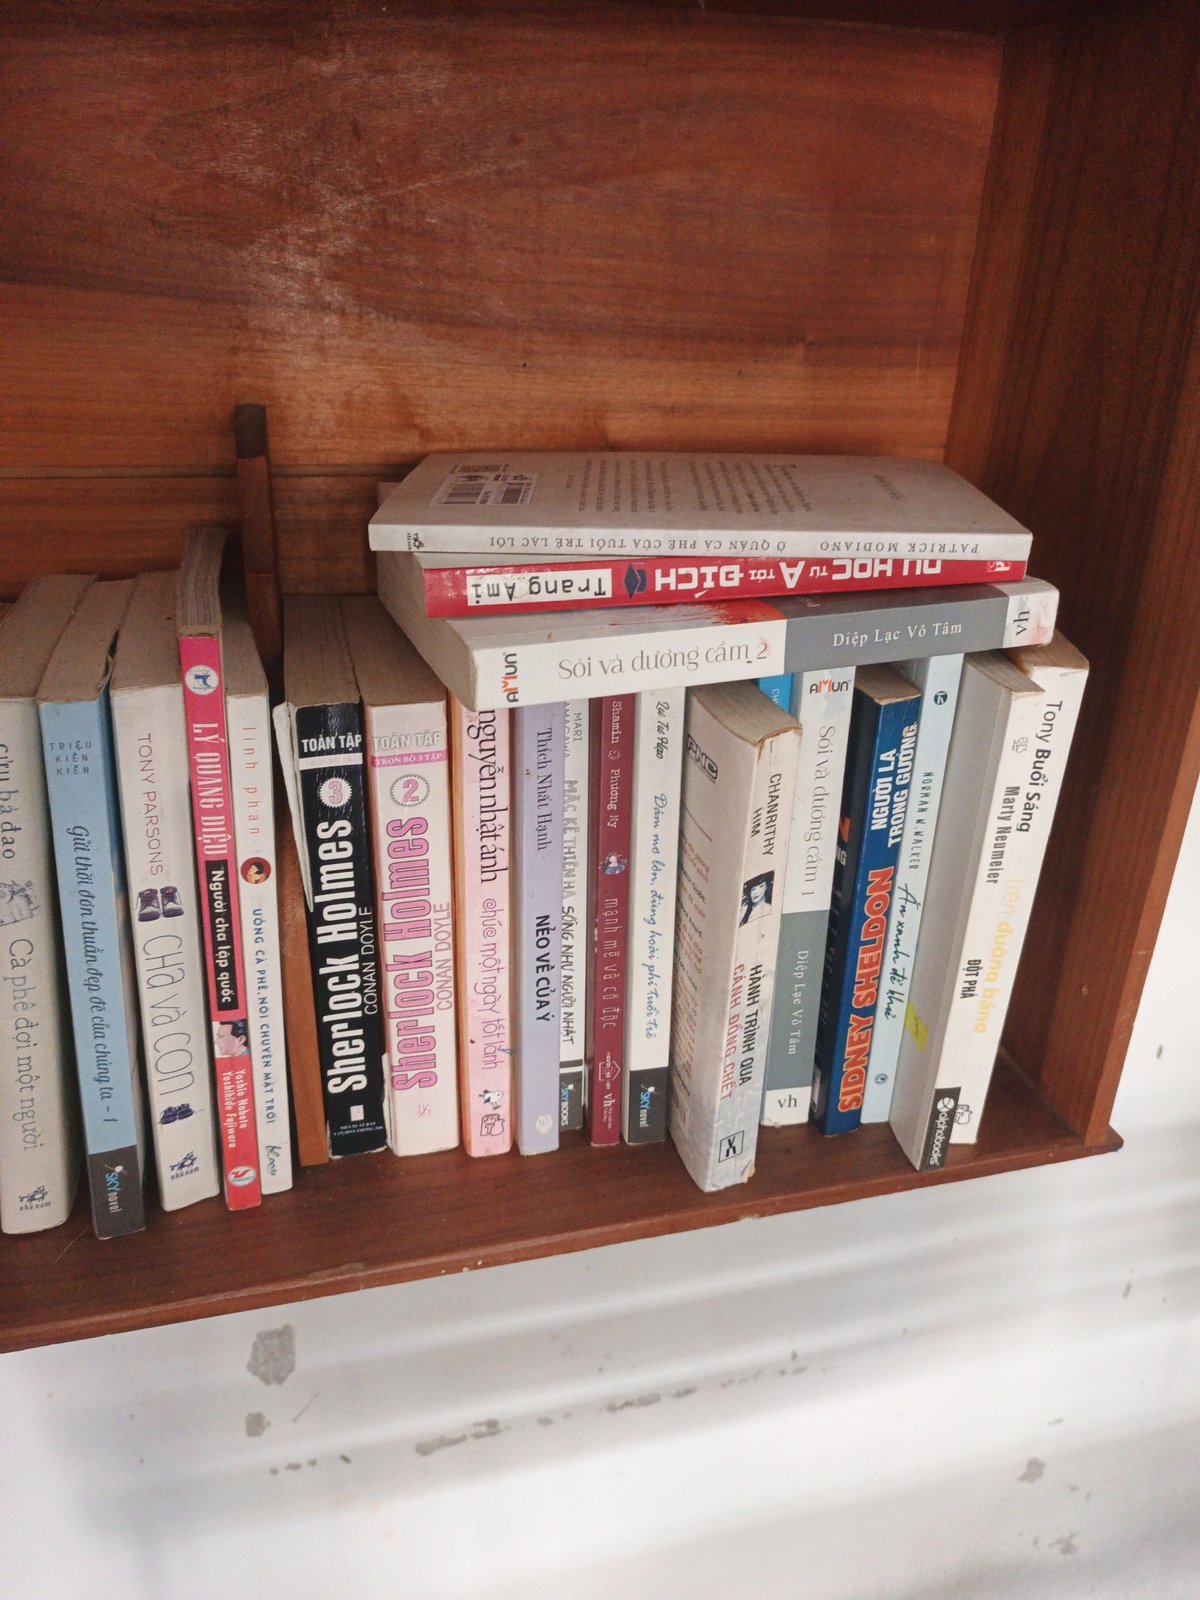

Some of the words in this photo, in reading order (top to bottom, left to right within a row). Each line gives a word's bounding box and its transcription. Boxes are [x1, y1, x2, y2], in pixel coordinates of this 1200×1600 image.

[520, 535, 548, 548] LẠC
[669, 538, 699, 554] PHÊ
[705, 539, 724, 554] CÀ
[729, 539, 771, 555] QUÁN
[820, 540, 900, 553] MODIANO
[908, 541, 980, 554] PATRICK
[528, 576, 606, 597] Trang
[655, 564, 745, 599] ĐÍCH
[780, 561, 806, 589] A
[471, 582, 516, 604] Ami
[832, 630, 869, 647] Diệp
[874, 627, 901, 643] Lạc
[907, 622, 926, 638] Vô
[931, 620, 962, 636] Tâm
[1013, 610, 1031, 636] vh
[558, 657, 592, 680] Sói
[598, 654, 624, 675] và
[631, 646, 699, 673] dương
[704, 640, 749, 664] cầm
[756, 643, 768, 660] 2
[192, 722, 225, 744] LÝ
[573, 712, 582, 741] MARI
[611, 700, 622, 744] Shamin
[1036, 700, 1063, 743] Tony
[242, 727, 260, 769] linh
[301, 734, 336, 753] TOÀN
[338, 732, 362, 751] TẬP
[466, 709, 505, 791] nguyễn
[536, 728, 553, 769] Thích
[653, 736, 669, 760] Hạo
[816, 725, 836, 754] Sói
[895, 720, 919, 785] GƯƠNG
[137, 733, 156, 783] TONY
[813, 759, 832, 780] và
[877, 748, 897, 772] LẠ
[1029, 749, 1052, 787] Buổi
[192, 752, 222, 809] QUANG
[328, 780, 343, 805] 3
[402, 779, 420, 801] 2
[536, 773, 554, 809] Nhất
[607, 768, 621, 811] Phương
[919, 771, 935, 813] NORMAN
[243, 787, 262, 834] phan
[475, 795, 509, 843] nhật
[762, 773, 782, 856] CHANRITHY
[804, 785, 831, 842] dương
[871, 776, 893, 830] NGƯỜI
[887, 785, 910, 848] TRONG
[996, 786, 1020, 821] Marty
[1017, 792, 1041, 833] Sáng
[66, 826, 90, 852] Gửi
[142, 791, 163, 876] PARSONS
[197, 815, 232, 856] DIỆU
[534, 813, 553, 851] Hạnh
[750, 808, 763, 838] HIM
[1, 821, 23, 860] đao
[651, 833, 661, 855] mơ
[986, 826, 1012, 884] Neumeier
[72, 857, 94, 885] thời
[381, 816, 434, 942] Holmes
[479, 844, 508, 885] ánh
[803, 846, 822, 883] cầm
[208, 870, 228, 913] Người
[314, 819, 360, 945] Holmes
[1003, 879, 1023, 914] trên
[77, 889, 96, 917] đơn
[602, 898, 622, 933] mạnh
[643, 889, 664, 925] đừng
[898, 883, 921, 917] Ăn
[215, 917, 230, 941] cha
[252, 908, 266, 944] UỐNG
[358, 906, 376, 955] DOYLE
[433, 902, 451, 953] DOYLE
[481, 898, 505, 939] chúc
[535, 915, 556, 948] NẺO
[561, 906, 579, 940] SỐNG
[9, 938, 35, 969] Cà
[81, 921, 105, 963] thuần
[602, 940, 620, 957] mẽ
[648, 930, 663, 960] hoài
[851, 866, 895, 1009] SHELDON
[893, 920, 910, 964] xanh
[984, 920, 1014, 982] đường
[213, 944, 235, 968] lập
[254, 950, 268, 965] CÀ
[478, 943, 503, 973] một
[535, 952, 555, 975] VỀ
[561, 945, 577, 971] NHƯ
[604, 964, 620, 980] và
[791, 950, 810, 979] Diệp
[962, 959, 983, 977] ĐỘT
[83, 968, 105, 991] đẹp
[214, 972, 239, 1003] quốc
[361, 962, 378, 1015] CONAN
[434, 960, 453, 1011] CONAN
[561, 975, 577, 1008] NGƯỜI
[641, 964, 662, 987] phí
[729, 964, 747, 1008] CÁNH
[746, 964, 769, 1005] HÀNH
[889, 967, 908, 985] để
[960, 980, 978, 999] PHÁ
[4, 975, 37, 1011] phê
[88, 996, 108, 1012] đẽ
[258, 997, 272, 1019] NÓI
[474, 976, 503, 1015] ngày
[535, 977, 556, 1010] CỦA
[602, 986, 619, 1000] cô
[645, 988, 660, 1016] tuổi
[791, 983, 806, 1005] Lạc
[150, 993, 188, 1027] và
[318, 953, 368, 1094] Sherlock
[384, 950, 438, 1091] Sherlock
[535, 1011, 556, 1022] Ý
[600, 1006, 621, 1028] độc
[790, 1009, 804, 1026] Vô
[9, 1017, 39, 1048] đợi
[91, 1015, 111, 1040] của
[480, 1018, 505, 1039] tốt
[559, 1012, 577, 1044] NHẬT
[645, 1018, 660, 1039] trẻ
[724, 1013, 745, 1058] ĐỒNG
[741, 1009, 760, 1053] TRÌNH
[788, 1029, 802, 1055] Tâm
[258, 1023, 274, 1068] CHUYỆN
[480, 1040, 505, 1070] lành
[16, 1055, 39, 1091] một
[93, 1043, 113, 1082] chúng
[738, 1059, 754, 1087] QUA
[838, 1013, 874, 1113] SIDNEY
[99, 1086, 116, 1100] ta
[222, 1071, 238, 1110] Yoshihide
[235, 1068, 248, 1097] Yoshio
[719, 1062, 741, 1102] CHẾT
[603, 1093, 616, 1107] vh
[778, 1095, 798, 1108] vh
[12, 1097, 44, 1151] người
[224, 1113, 238, 1149] Fujiwara
[930, 1112, 951, 1166] alphabooks
